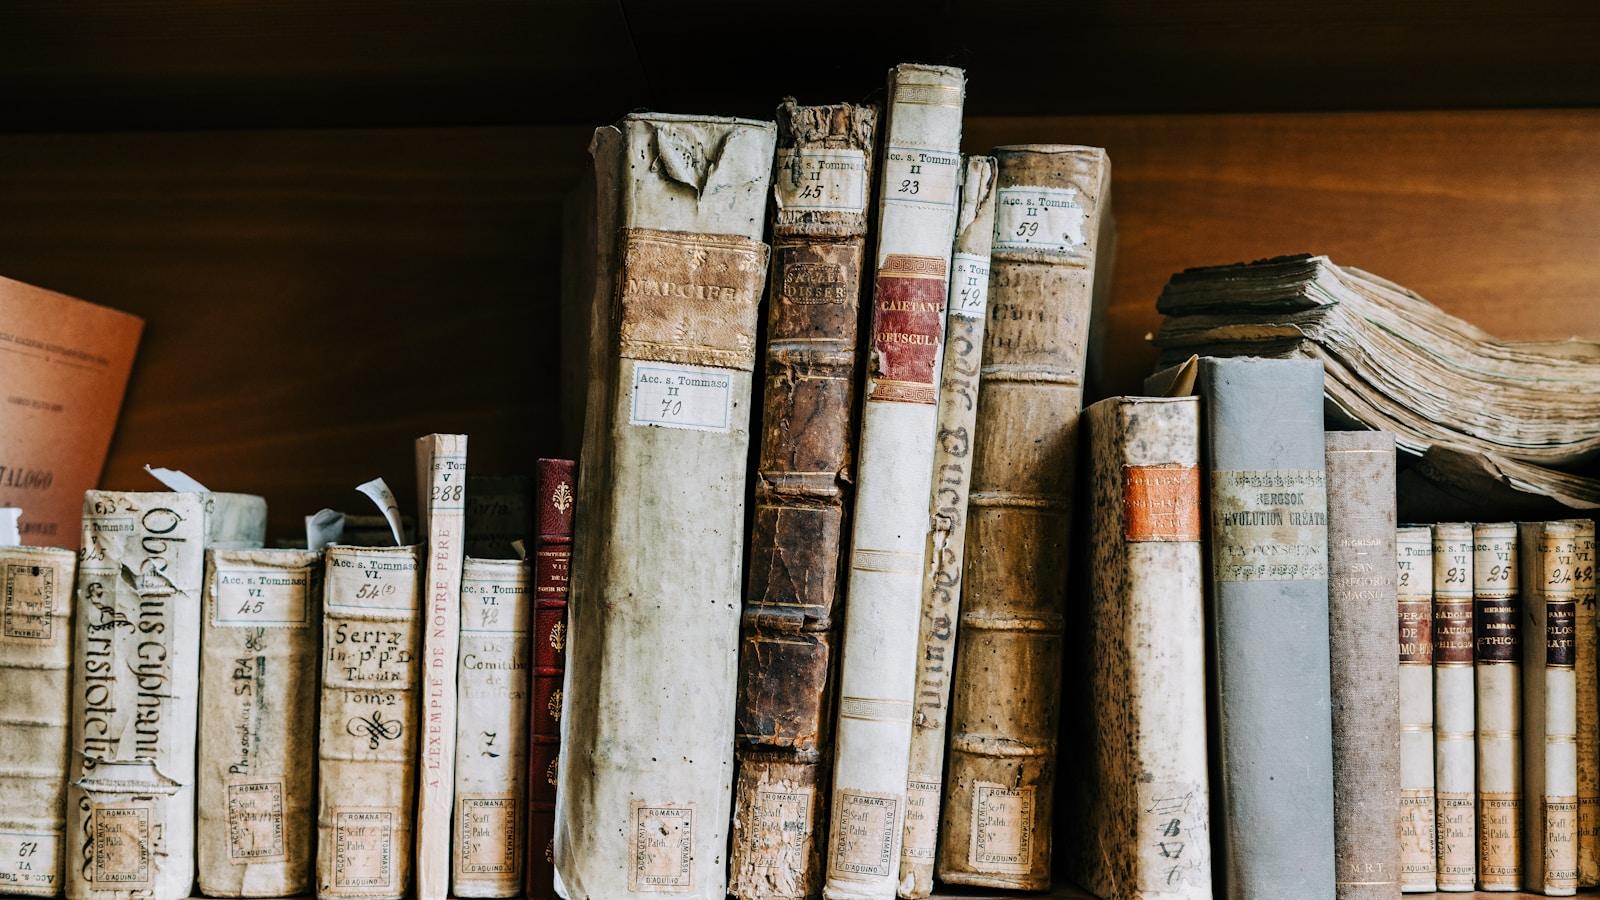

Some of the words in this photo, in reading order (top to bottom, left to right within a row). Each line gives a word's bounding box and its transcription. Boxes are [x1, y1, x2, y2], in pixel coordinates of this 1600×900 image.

[910, 165, 922, 174] II
[810, 172, 820, 181] II
[800, 184, 824, 199] 45
[898, 180, 920, 194] 23
[1002, 196, 1024, 206] Acc.
[1026, 208, 1038, 216] II
[1016, 222, 1039, 237] 59
[968, 277, 976, 286] II
[788, 286, 844, 298] DISSER
[640, 374, 662, 384] Acc.
[678, 376, 728, 388] Tommaso
[668, 387, 680, 396] II
[662, 399, 682, 418] 70
[443, 474, 452, 482] V
[1576, 552, 1592, 561] VI.
[333, 558, 354, 568] Acc.
[370, 560, 418, 570] Tommaso
[365, 570, 382, 580] VI.
[1445, 567, 1466, 584] 23
[1486, 565, 1512, 582] 25
[1548, 568, 1572, 584] 24
[1574, 566, 1592, 582] 42
[222, 576, 244, 584] Acc.
[259, 576, 306, 586] Tommaso
[238, 600, 264, 614] 45
[482, 596, 500, 606] VI.
[434, 582, 448, 638] NOTRE
[1402, 628, 1418, 638] DE
[432, 650, 444, 668] DE
[430, 678, 443, 770] L'EXEMPLE
[854, 797, 884, 806] ROMANA
[838, 808, 849, 856] ACCADEMIA
[882, 827, 892, 862] TOMMASO
[845, 864, 878, 873] D'AQUINO
